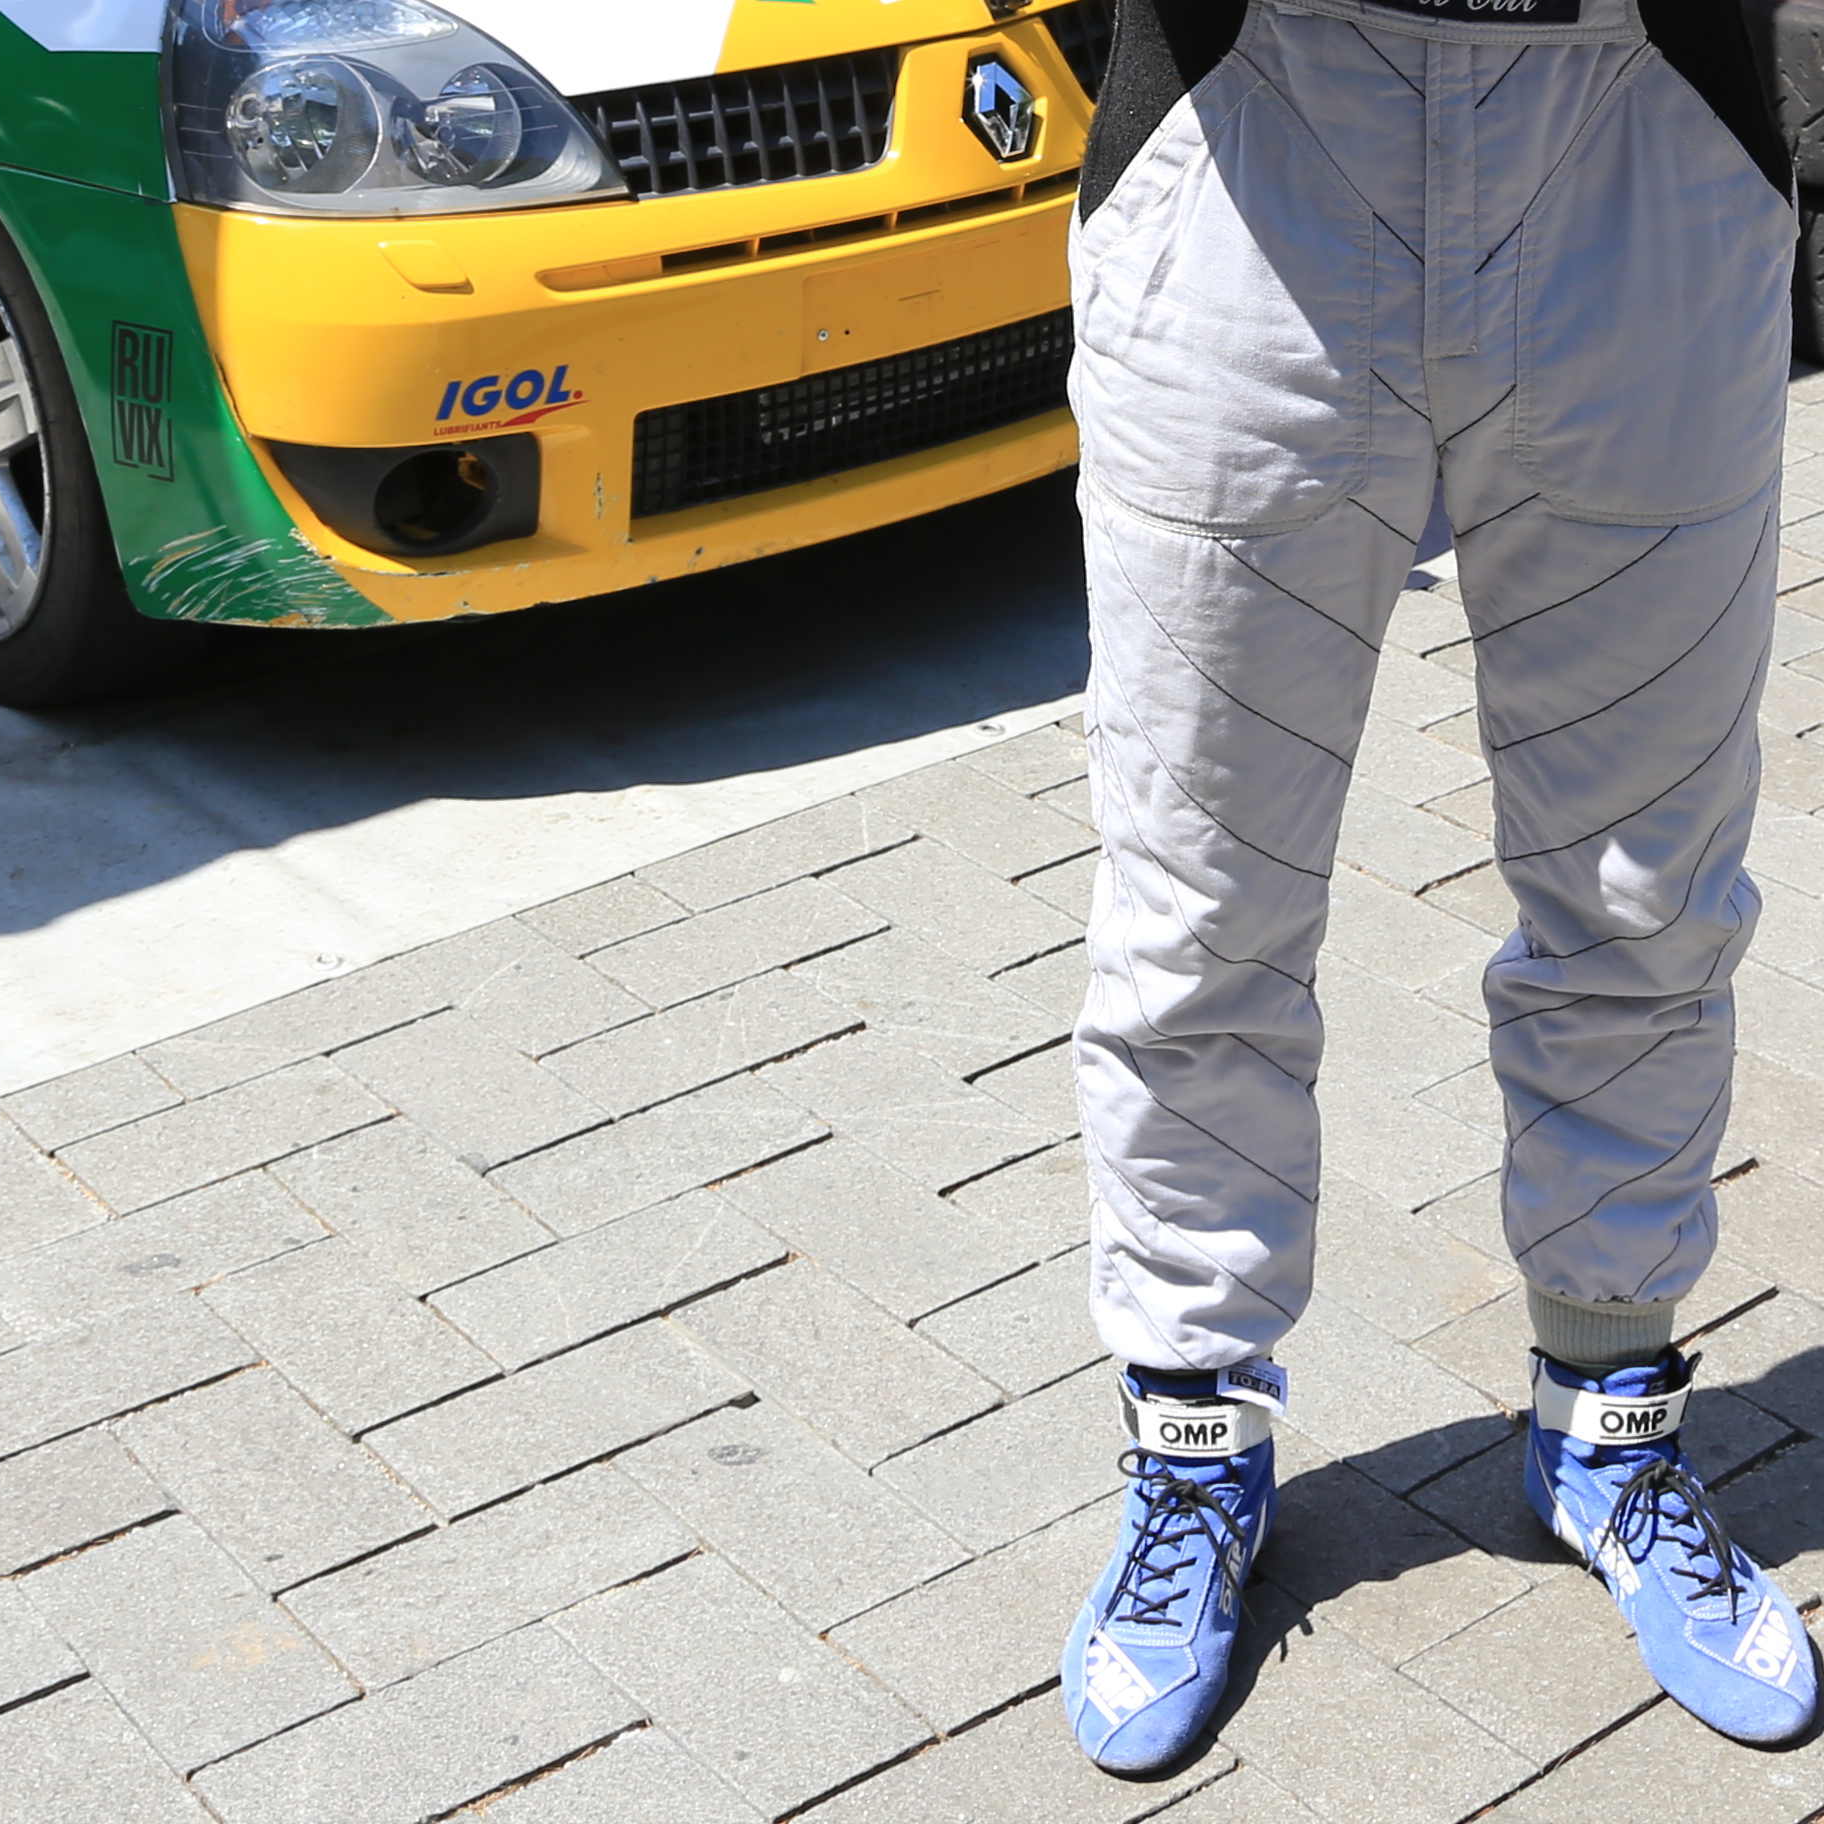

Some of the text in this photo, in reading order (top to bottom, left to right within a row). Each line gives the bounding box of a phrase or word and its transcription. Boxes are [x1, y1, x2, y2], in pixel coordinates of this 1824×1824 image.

[433, 419, 504, 436] LUBRIFIANTS
[1159, 1421, 1228, 1445] OMP
[1600, 1406, 1668, 1434] OMP
[1745, 1609, 1794, 1678] OMP
[1086, 1644, 1147, 1710] OMP
